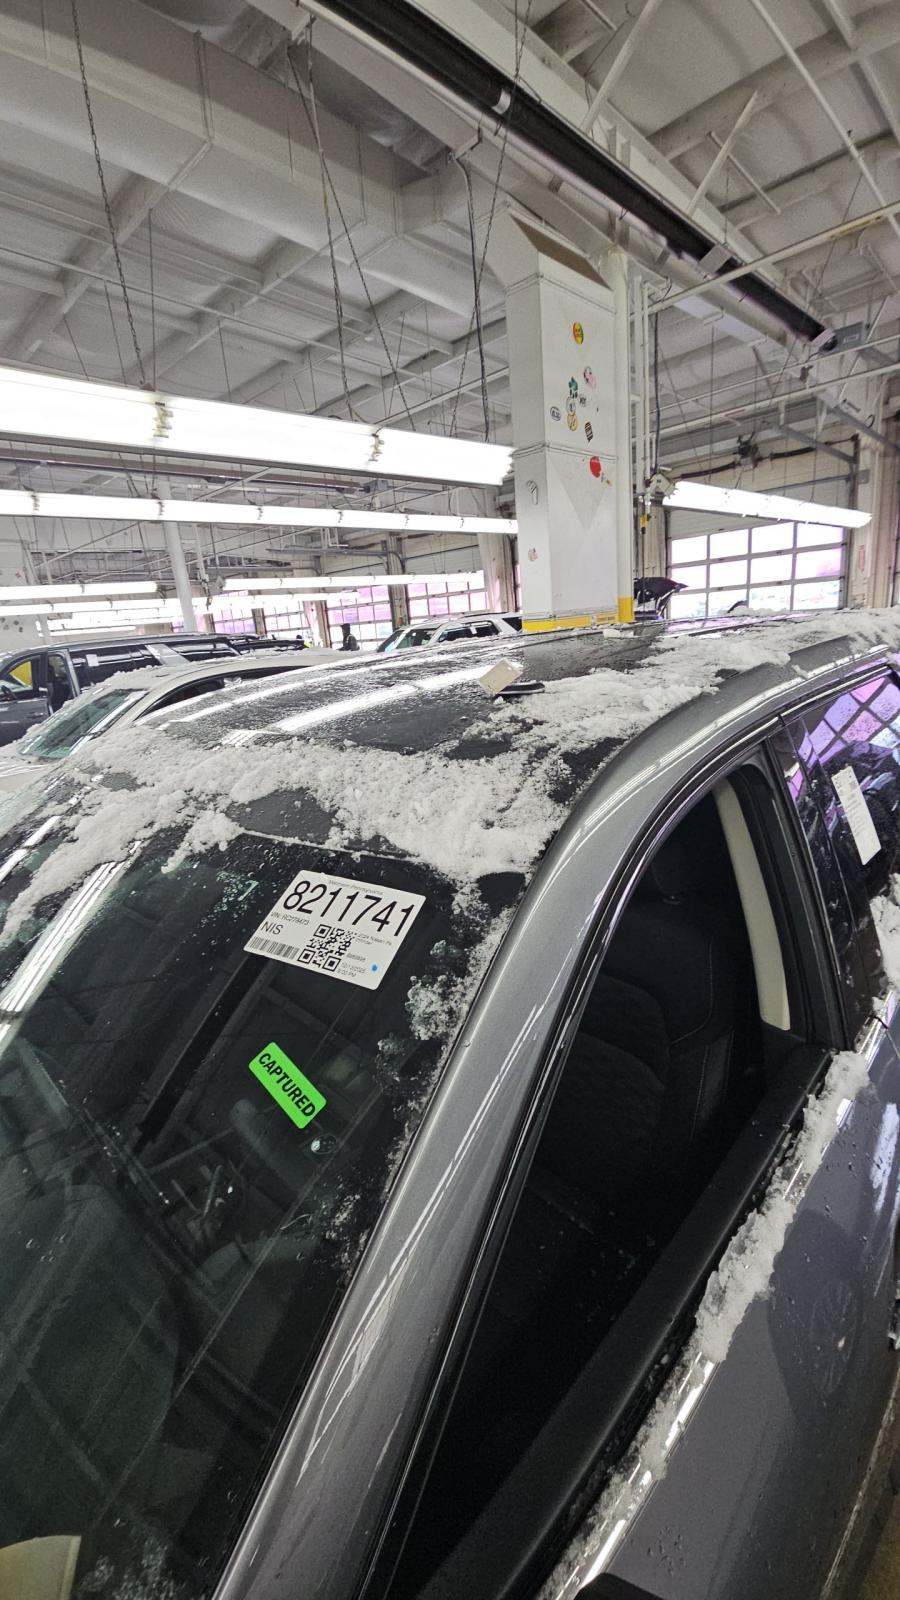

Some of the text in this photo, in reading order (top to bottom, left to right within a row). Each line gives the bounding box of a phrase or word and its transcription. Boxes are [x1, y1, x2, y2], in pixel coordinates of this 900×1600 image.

[260, 921, 283, 935] NIS
[283, 880, 415, 937] 8211741
[258, 1052, 316, 1117] CAPTURED
